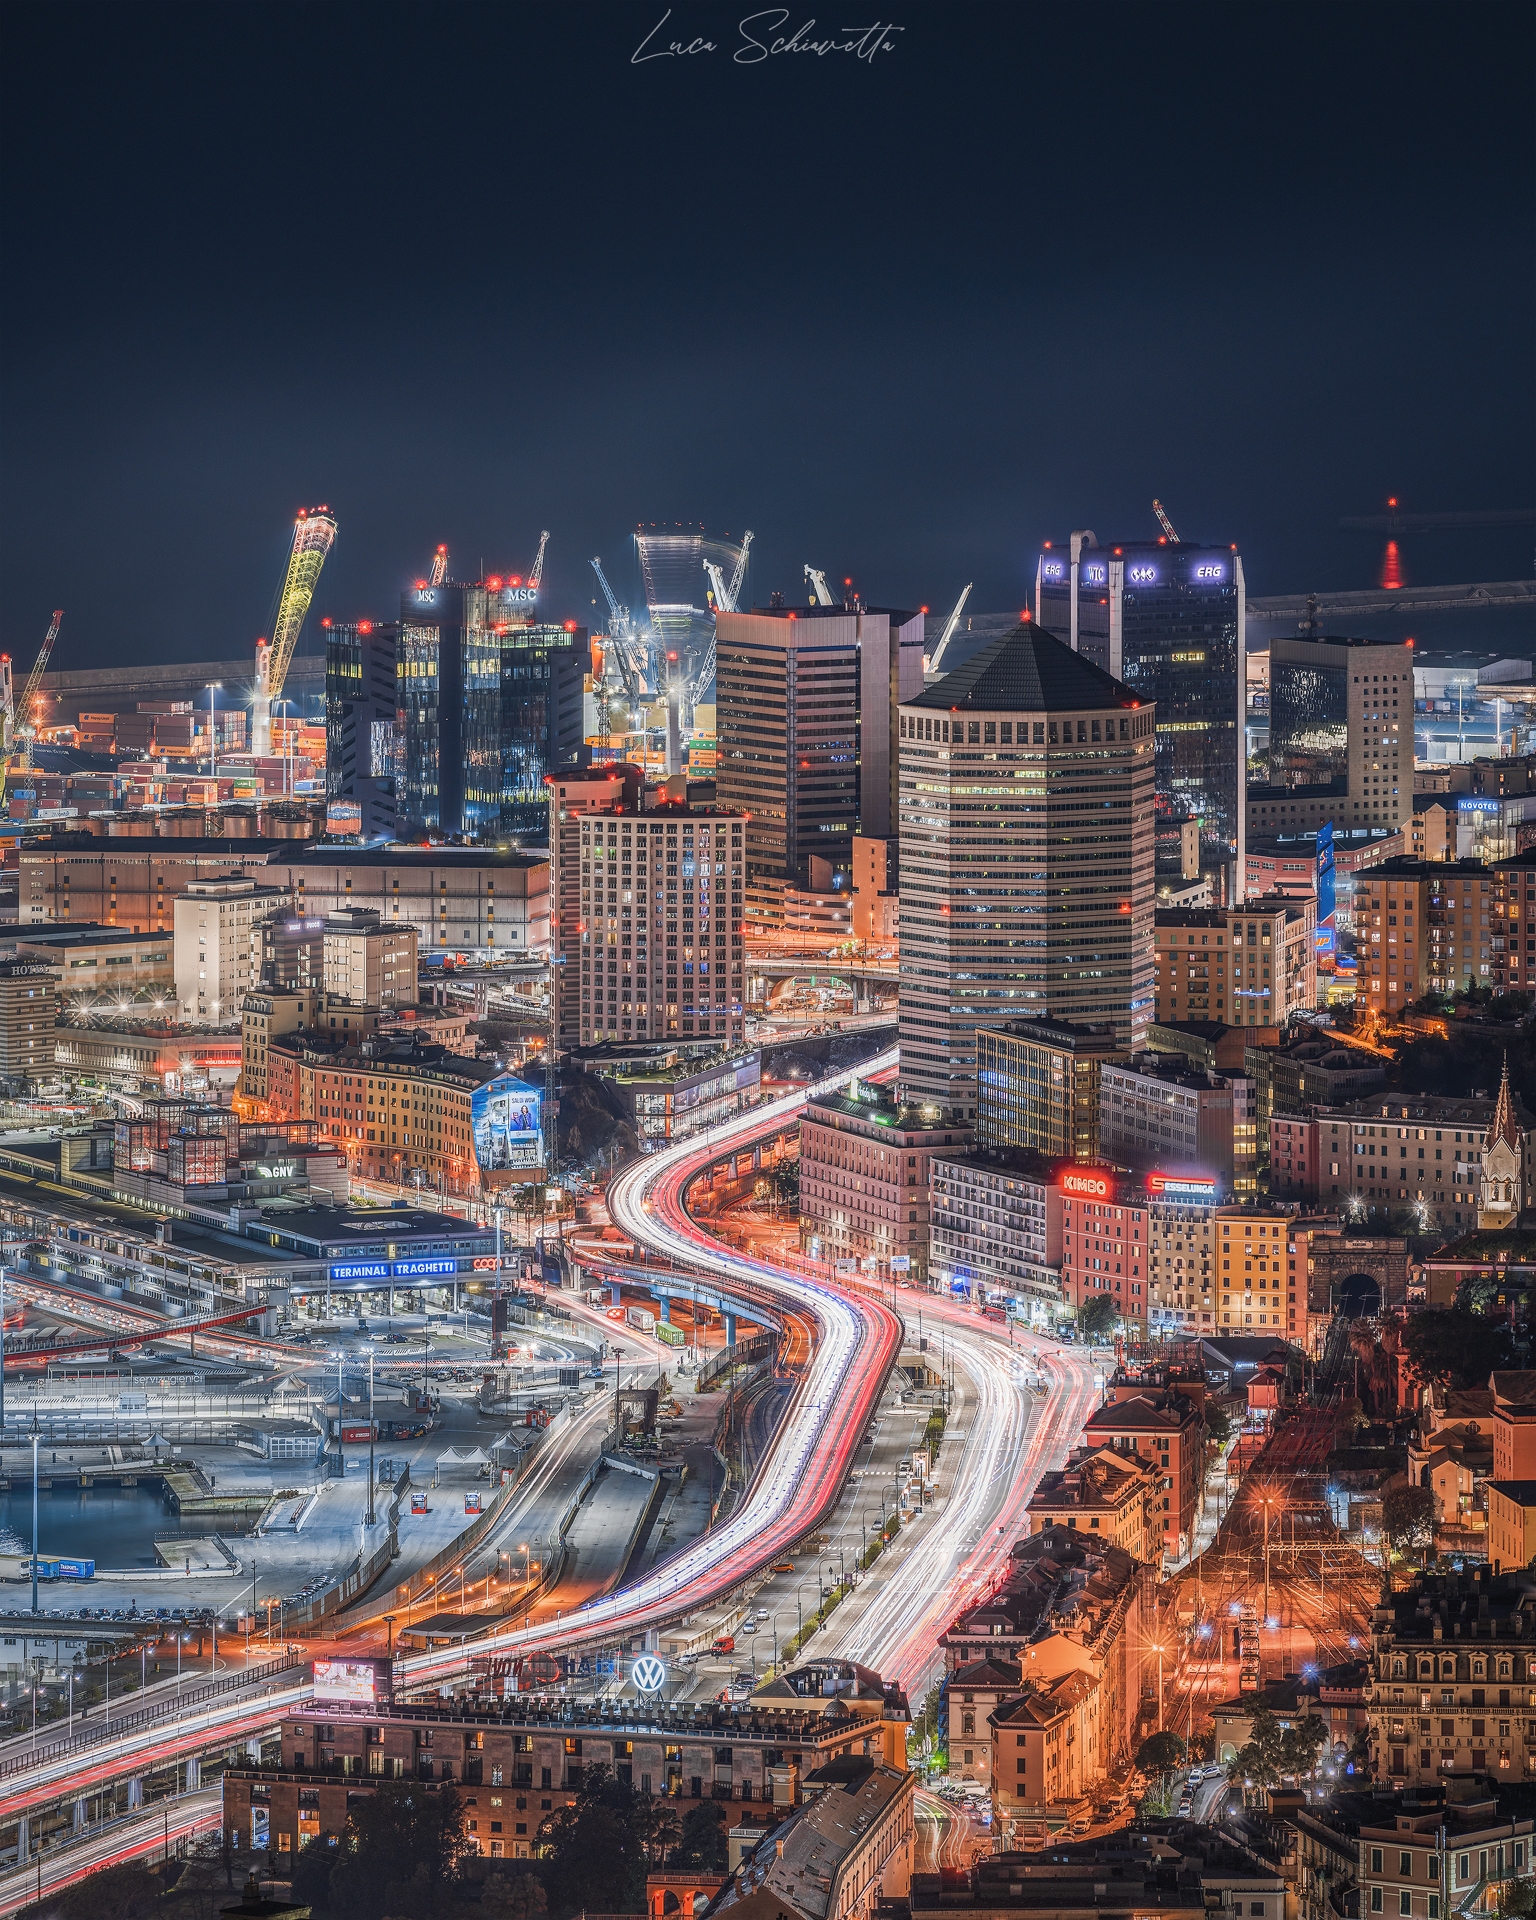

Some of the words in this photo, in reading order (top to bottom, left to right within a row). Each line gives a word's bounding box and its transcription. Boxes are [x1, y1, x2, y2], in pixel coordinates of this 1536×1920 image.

[1045, 565, 1060, 575] ERG
[1088, 566, 1104, 581] WTC
[1197, 566, 1221, 577] ERG
[418, 590, 434, 602] MSC
[508, 589, 537, 601] MSC
[1460, 802, 1497, 810] NOVOTEL
[11, 964, 50, 976] HOTEL
[273, 1166, 293, 1178] GNV
[1063, 1175, 1106, 1195] KIMBO
[334, 1266, 386, 1278] TERMINAL
[396, 1262, 453, 1274] TRAGHETTI
[1425, 1737, 1506, 1747] MIRAMARE
